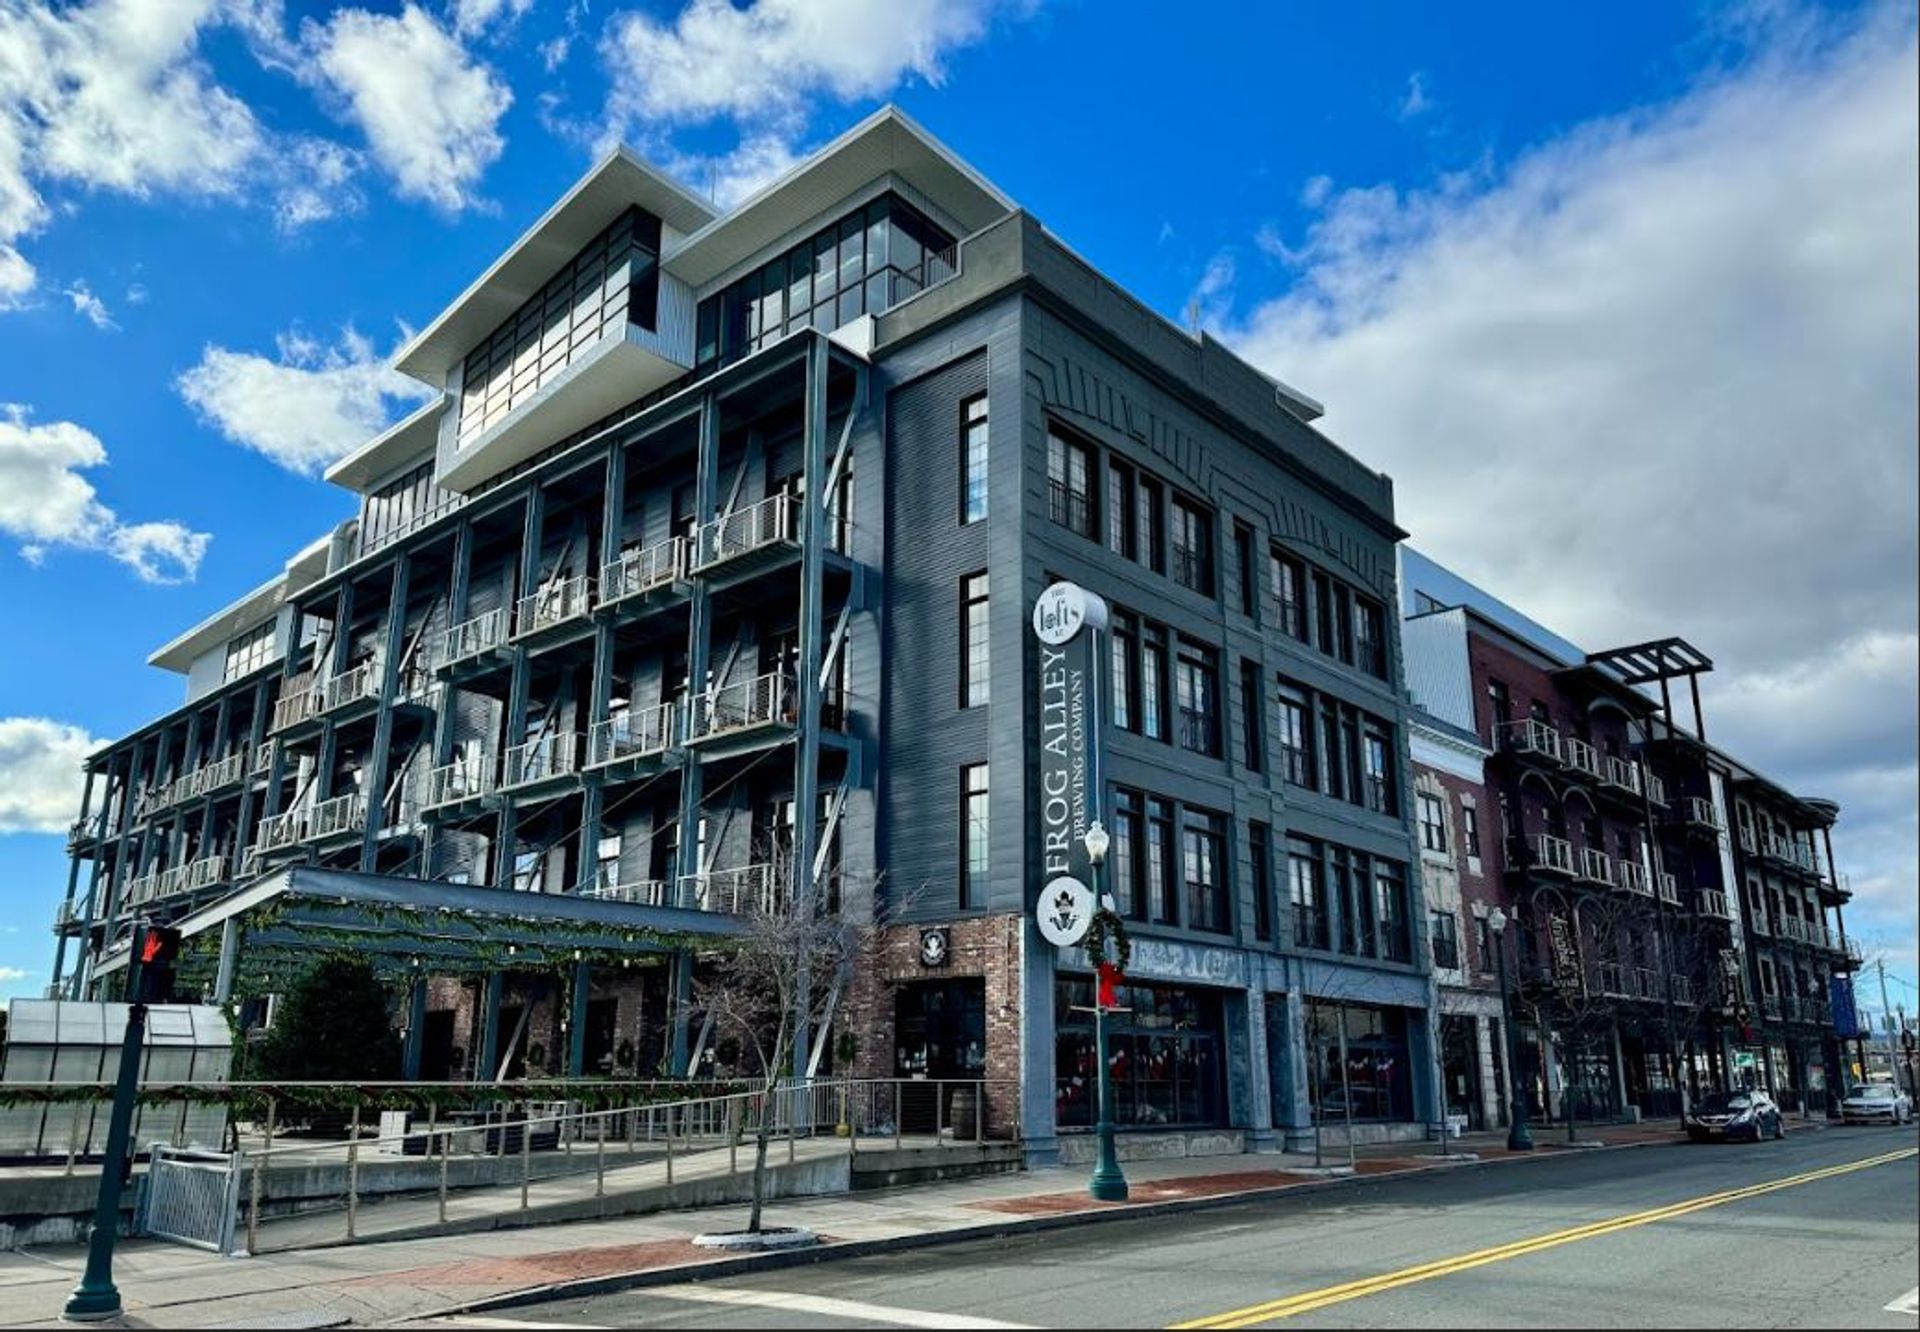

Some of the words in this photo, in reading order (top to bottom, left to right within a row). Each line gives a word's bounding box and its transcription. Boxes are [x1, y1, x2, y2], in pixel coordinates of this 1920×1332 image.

[1042, 648, 1067, 757] ALLEY
[1070, 669, 1084, 752] COMPANY
[1044, 769, 1069, 875] FROG
[1072, 757, 1086, 842] BREWING
